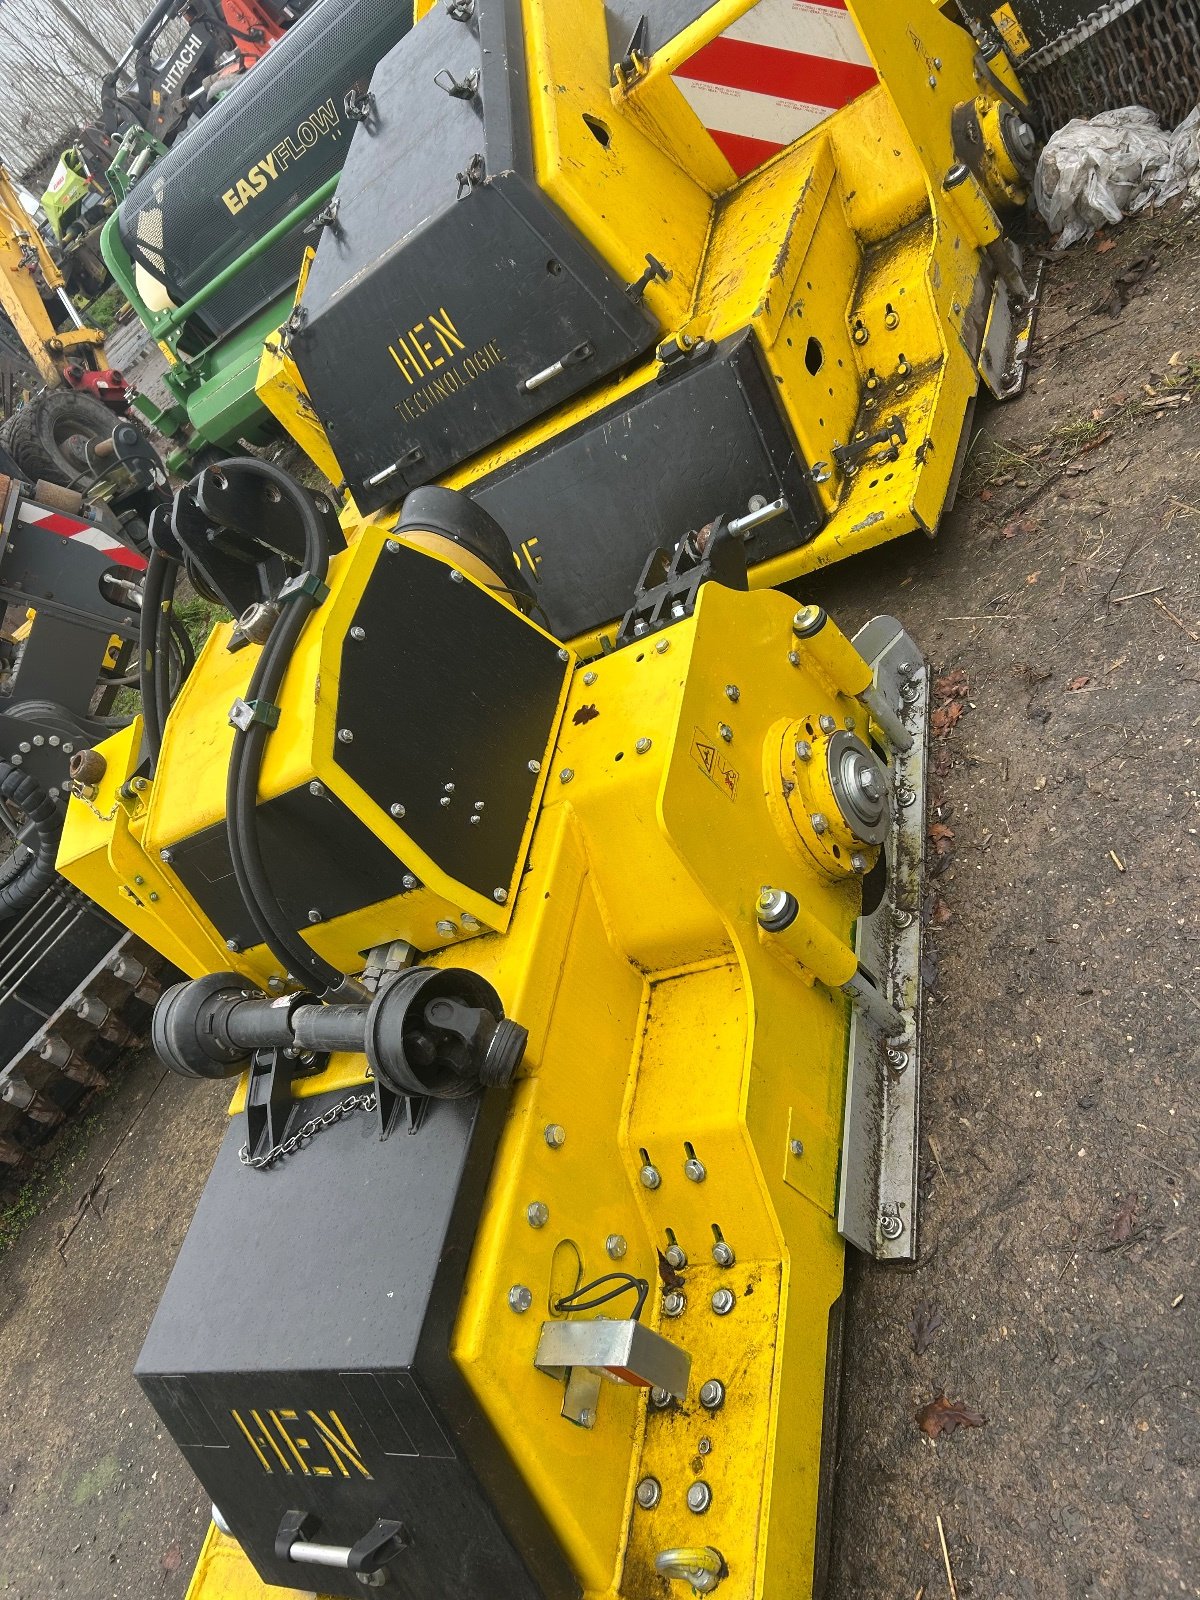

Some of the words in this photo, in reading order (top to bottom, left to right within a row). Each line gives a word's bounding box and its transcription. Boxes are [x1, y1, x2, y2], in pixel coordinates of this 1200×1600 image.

[161, 33, 203, 95] HITACHI
[221, 98, 340, 216] EASYFLOW
[388, 307, 465, 385] HEN
[393, 338, 507, 423] TECHNOLOGIE
[230, 1409, 375, 1480] HEN
